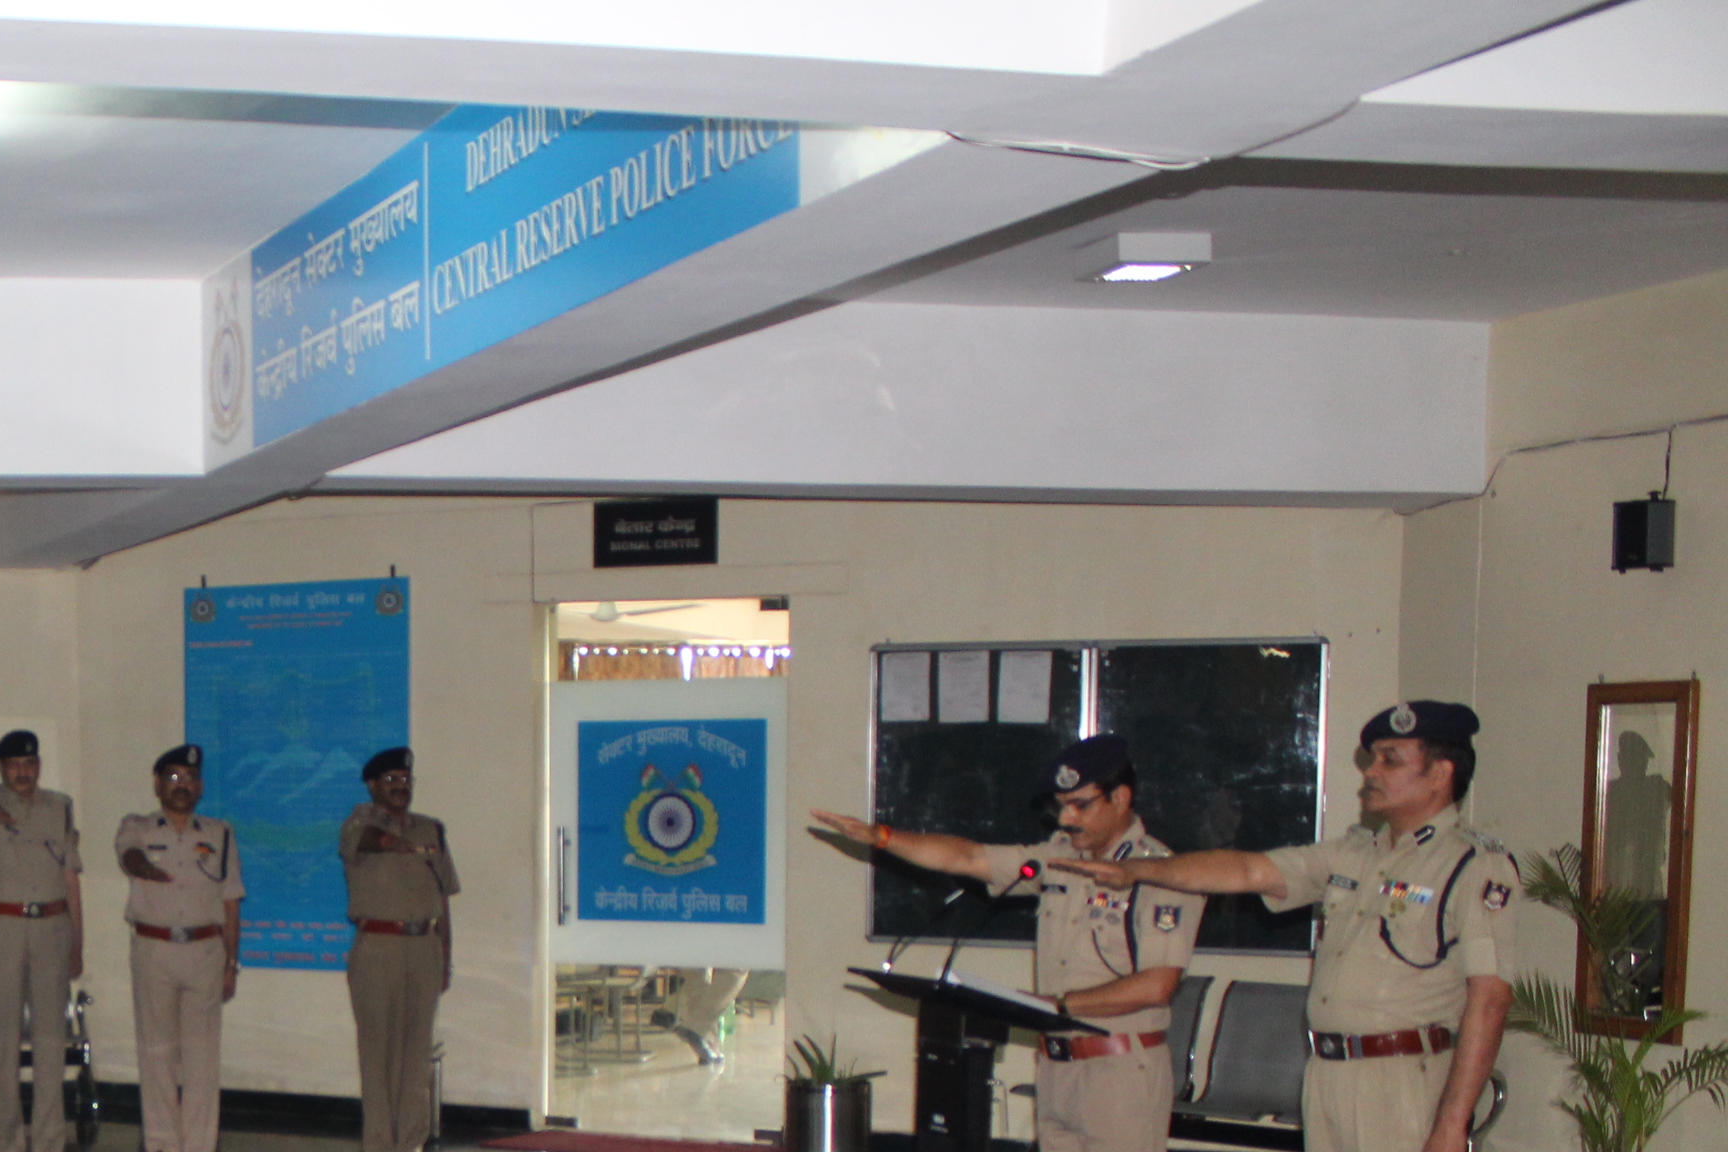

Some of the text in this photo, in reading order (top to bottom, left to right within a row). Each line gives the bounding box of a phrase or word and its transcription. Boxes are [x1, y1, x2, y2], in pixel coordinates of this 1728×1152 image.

[304, 232, 345, 289] सेक्टर
[348, 179, 419, 277] मुख्यालय
[433, 228, 513, 315] CENTRAL
[515, 175, 606, 274] RESERVE
[610, 125, 696, 226] POLICE
[300, 307, 338, 378] रिजर्व
[341, 296, 387, 375] पुलिस
[389, 280, 420, 331] बल
[610, 537, 701, 551] SIGNAL CENTRE
[682, 886, 721, 919] पुलिस
[725, 894, 748, 913] बल
